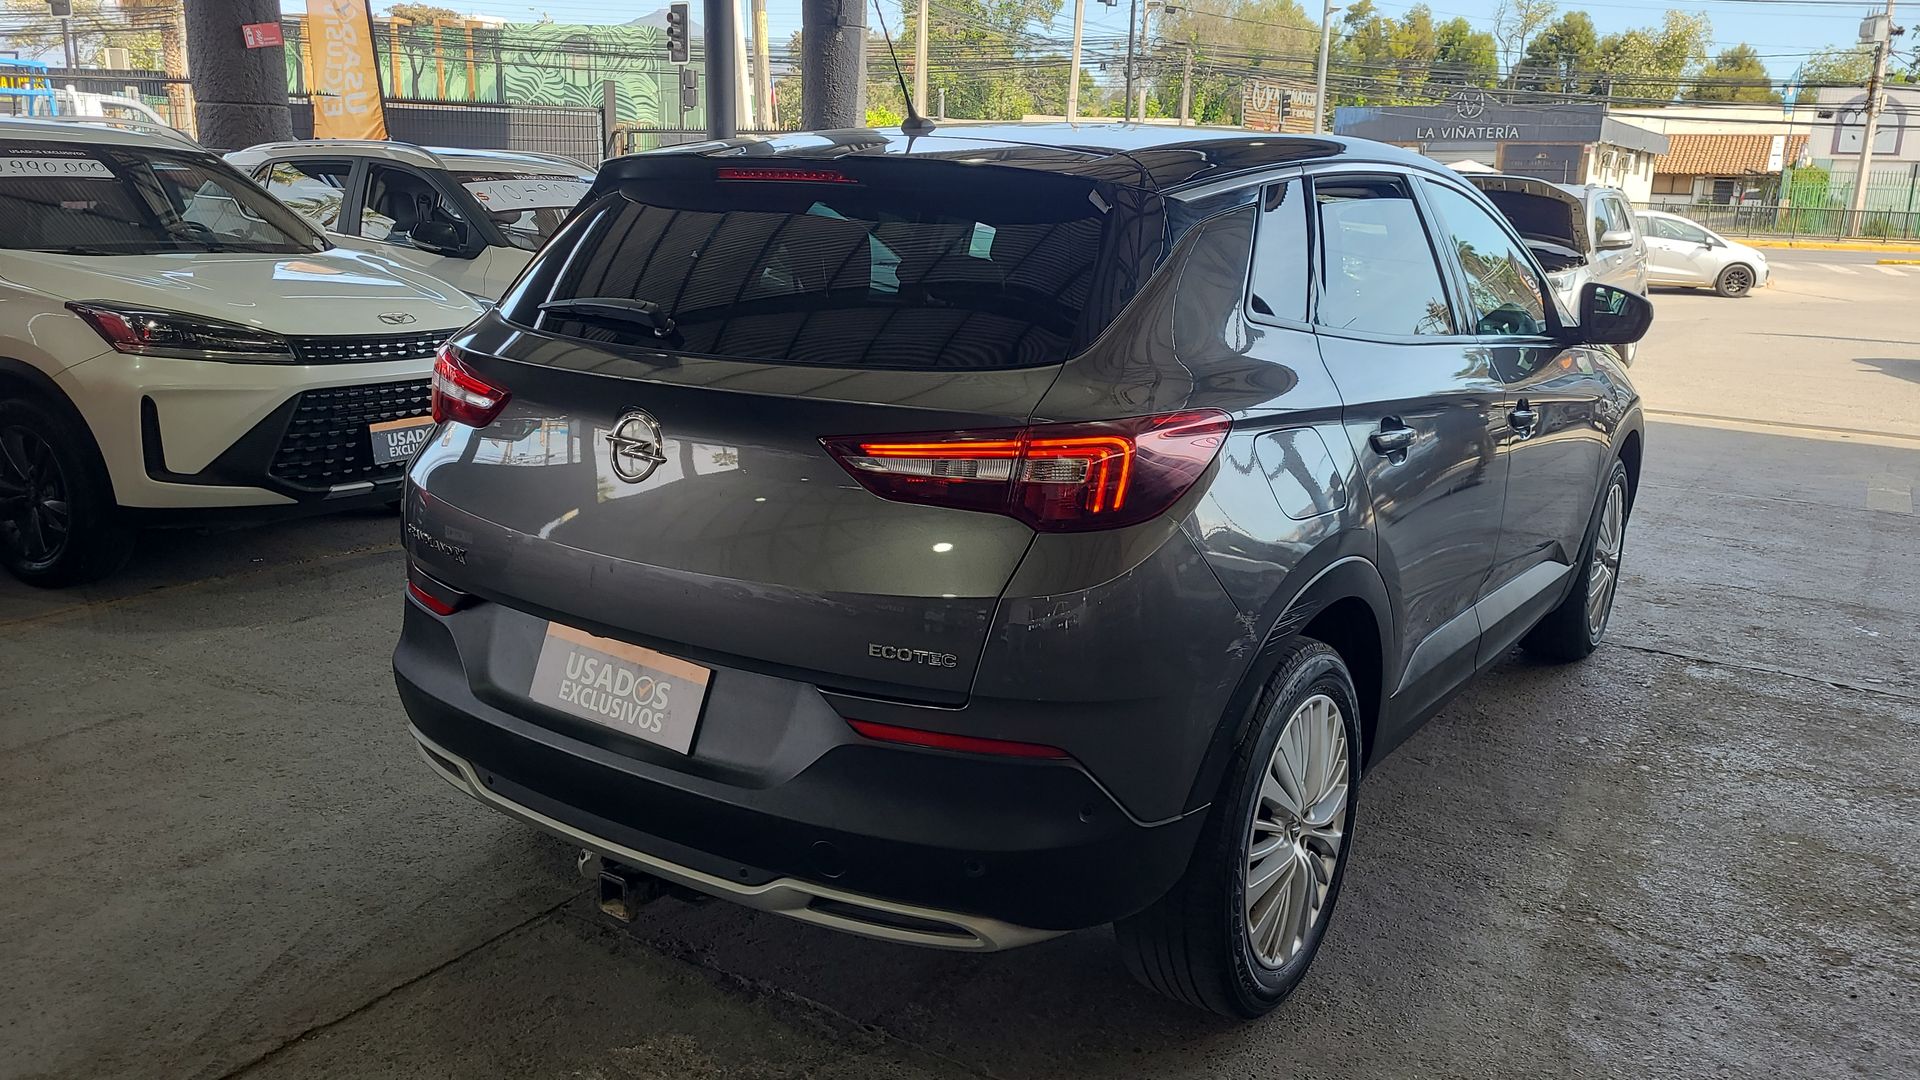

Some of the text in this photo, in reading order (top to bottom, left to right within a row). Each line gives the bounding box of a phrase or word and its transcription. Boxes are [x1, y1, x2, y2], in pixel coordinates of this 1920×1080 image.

[1416, 125, 1520, 139] LA VIÑATERÍA
[0, 160, 106, 174] .990.000
[387, 427, 432, 447] USAD
[868, 642, 958, 668] ECOTEC
[565, 651, 672, 710] USADOS
[558, 679, 665, 734] EXCLUSIVOS
